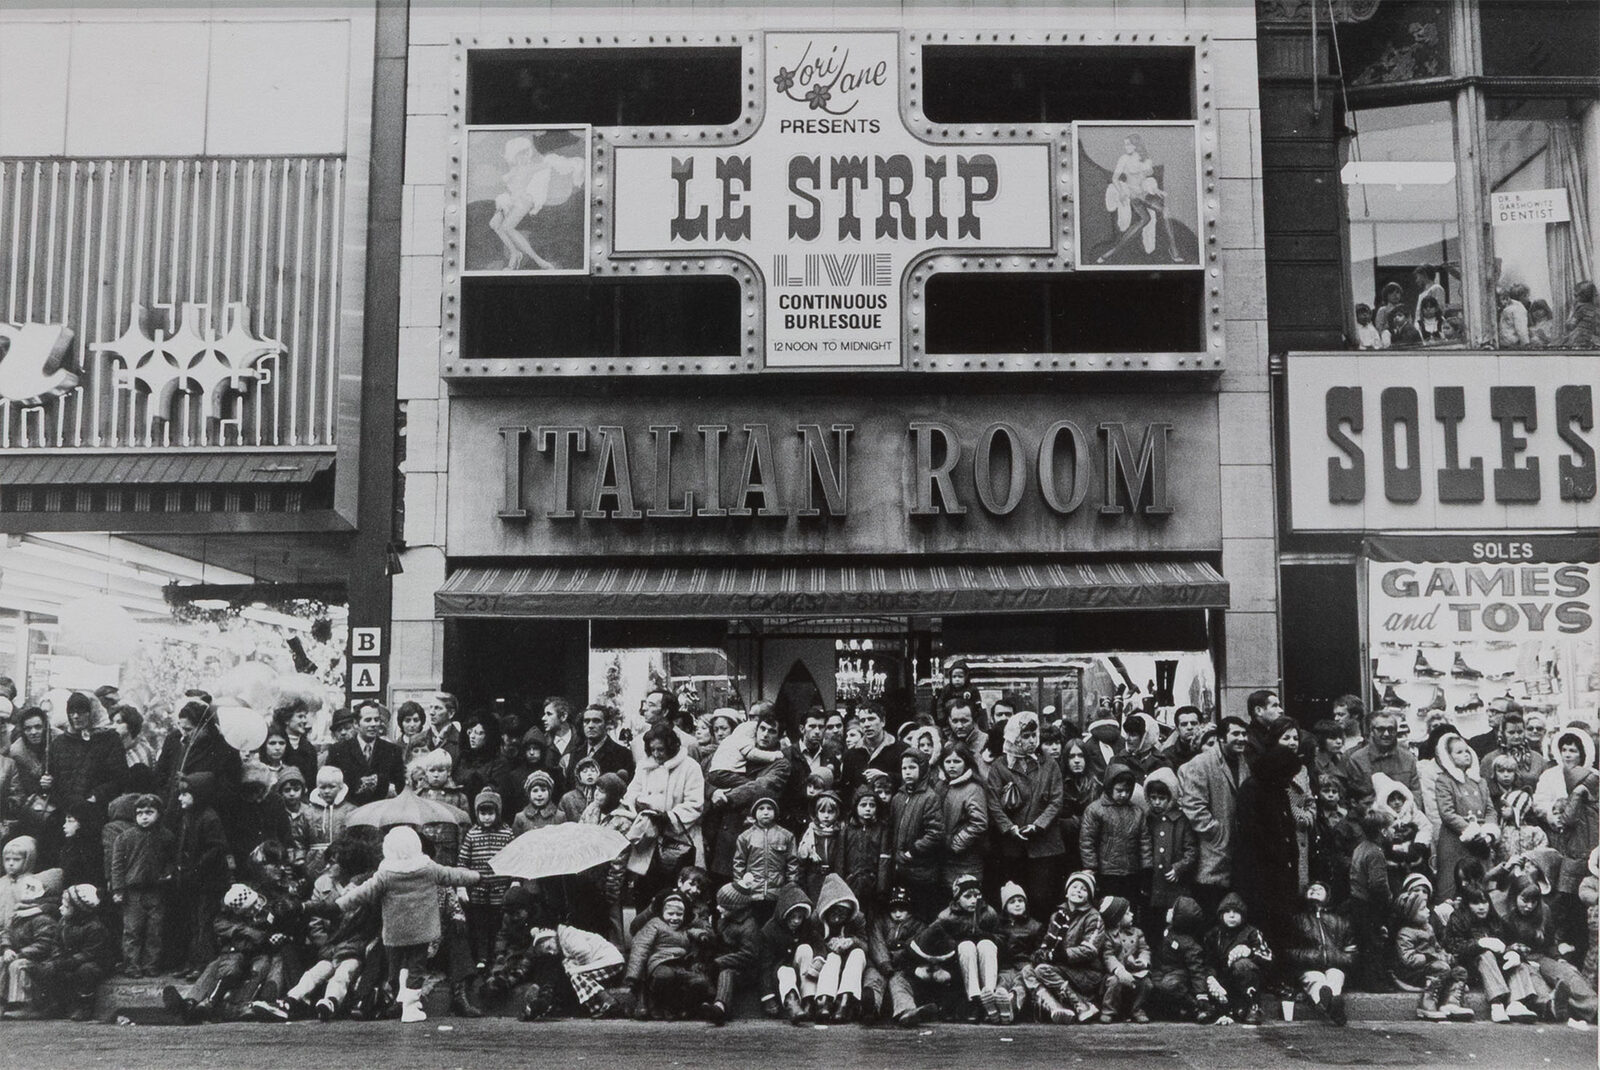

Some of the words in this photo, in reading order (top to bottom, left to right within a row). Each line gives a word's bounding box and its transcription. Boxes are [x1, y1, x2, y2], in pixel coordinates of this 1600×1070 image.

[780, 118, 881, 134] PRESENTS
[670, 154, 751, 242] LE
[787, 153, 998, 242] STRIP
[1500, 208, 1554, 222] DENTIST
[773, 252, 892, 287] LIVE
[779, 293, 888, 310] CONTINUOUS
[784, 313, 882, 330] BURLESQUE
[773, 342, 784, 352] 12
[785, 341, 818, 352] NOON
[822, 341, 838, 352] TO
[840, 340, 893, 351] MIDNIGHT
[1325, 384, 1598, 505] SOLES
[497, 422, 855, 519] ITALIAN
[908, 419, 1174, 515] ROOM
[1472, 542, 1534, 559] SOLES
[1381, 565, 1591, 599] GAMES
[1382, 603, 1441, 632] and
[1449, 600, 1593, 635] TOYS
